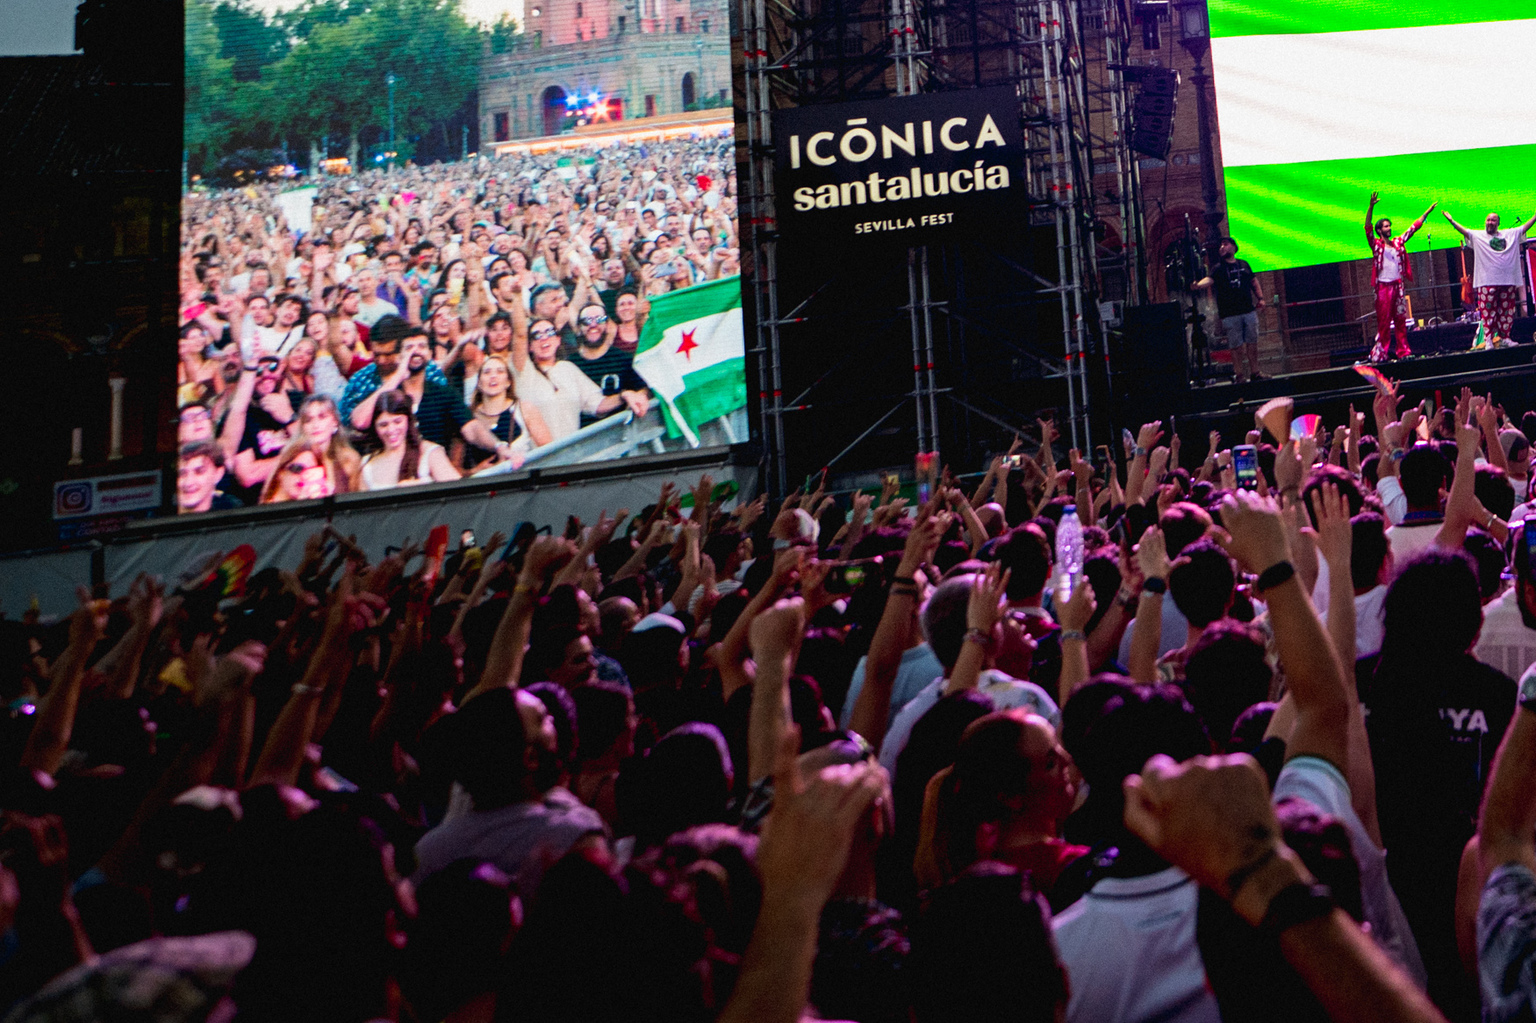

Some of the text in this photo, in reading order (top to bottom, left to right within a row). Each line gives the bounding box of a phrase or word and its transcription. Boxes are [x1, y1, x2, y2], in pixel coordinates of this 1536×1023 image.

[793, 159, 1010, 212] santalucía
[854, 212, 954, 234] SEVILLA FEST
